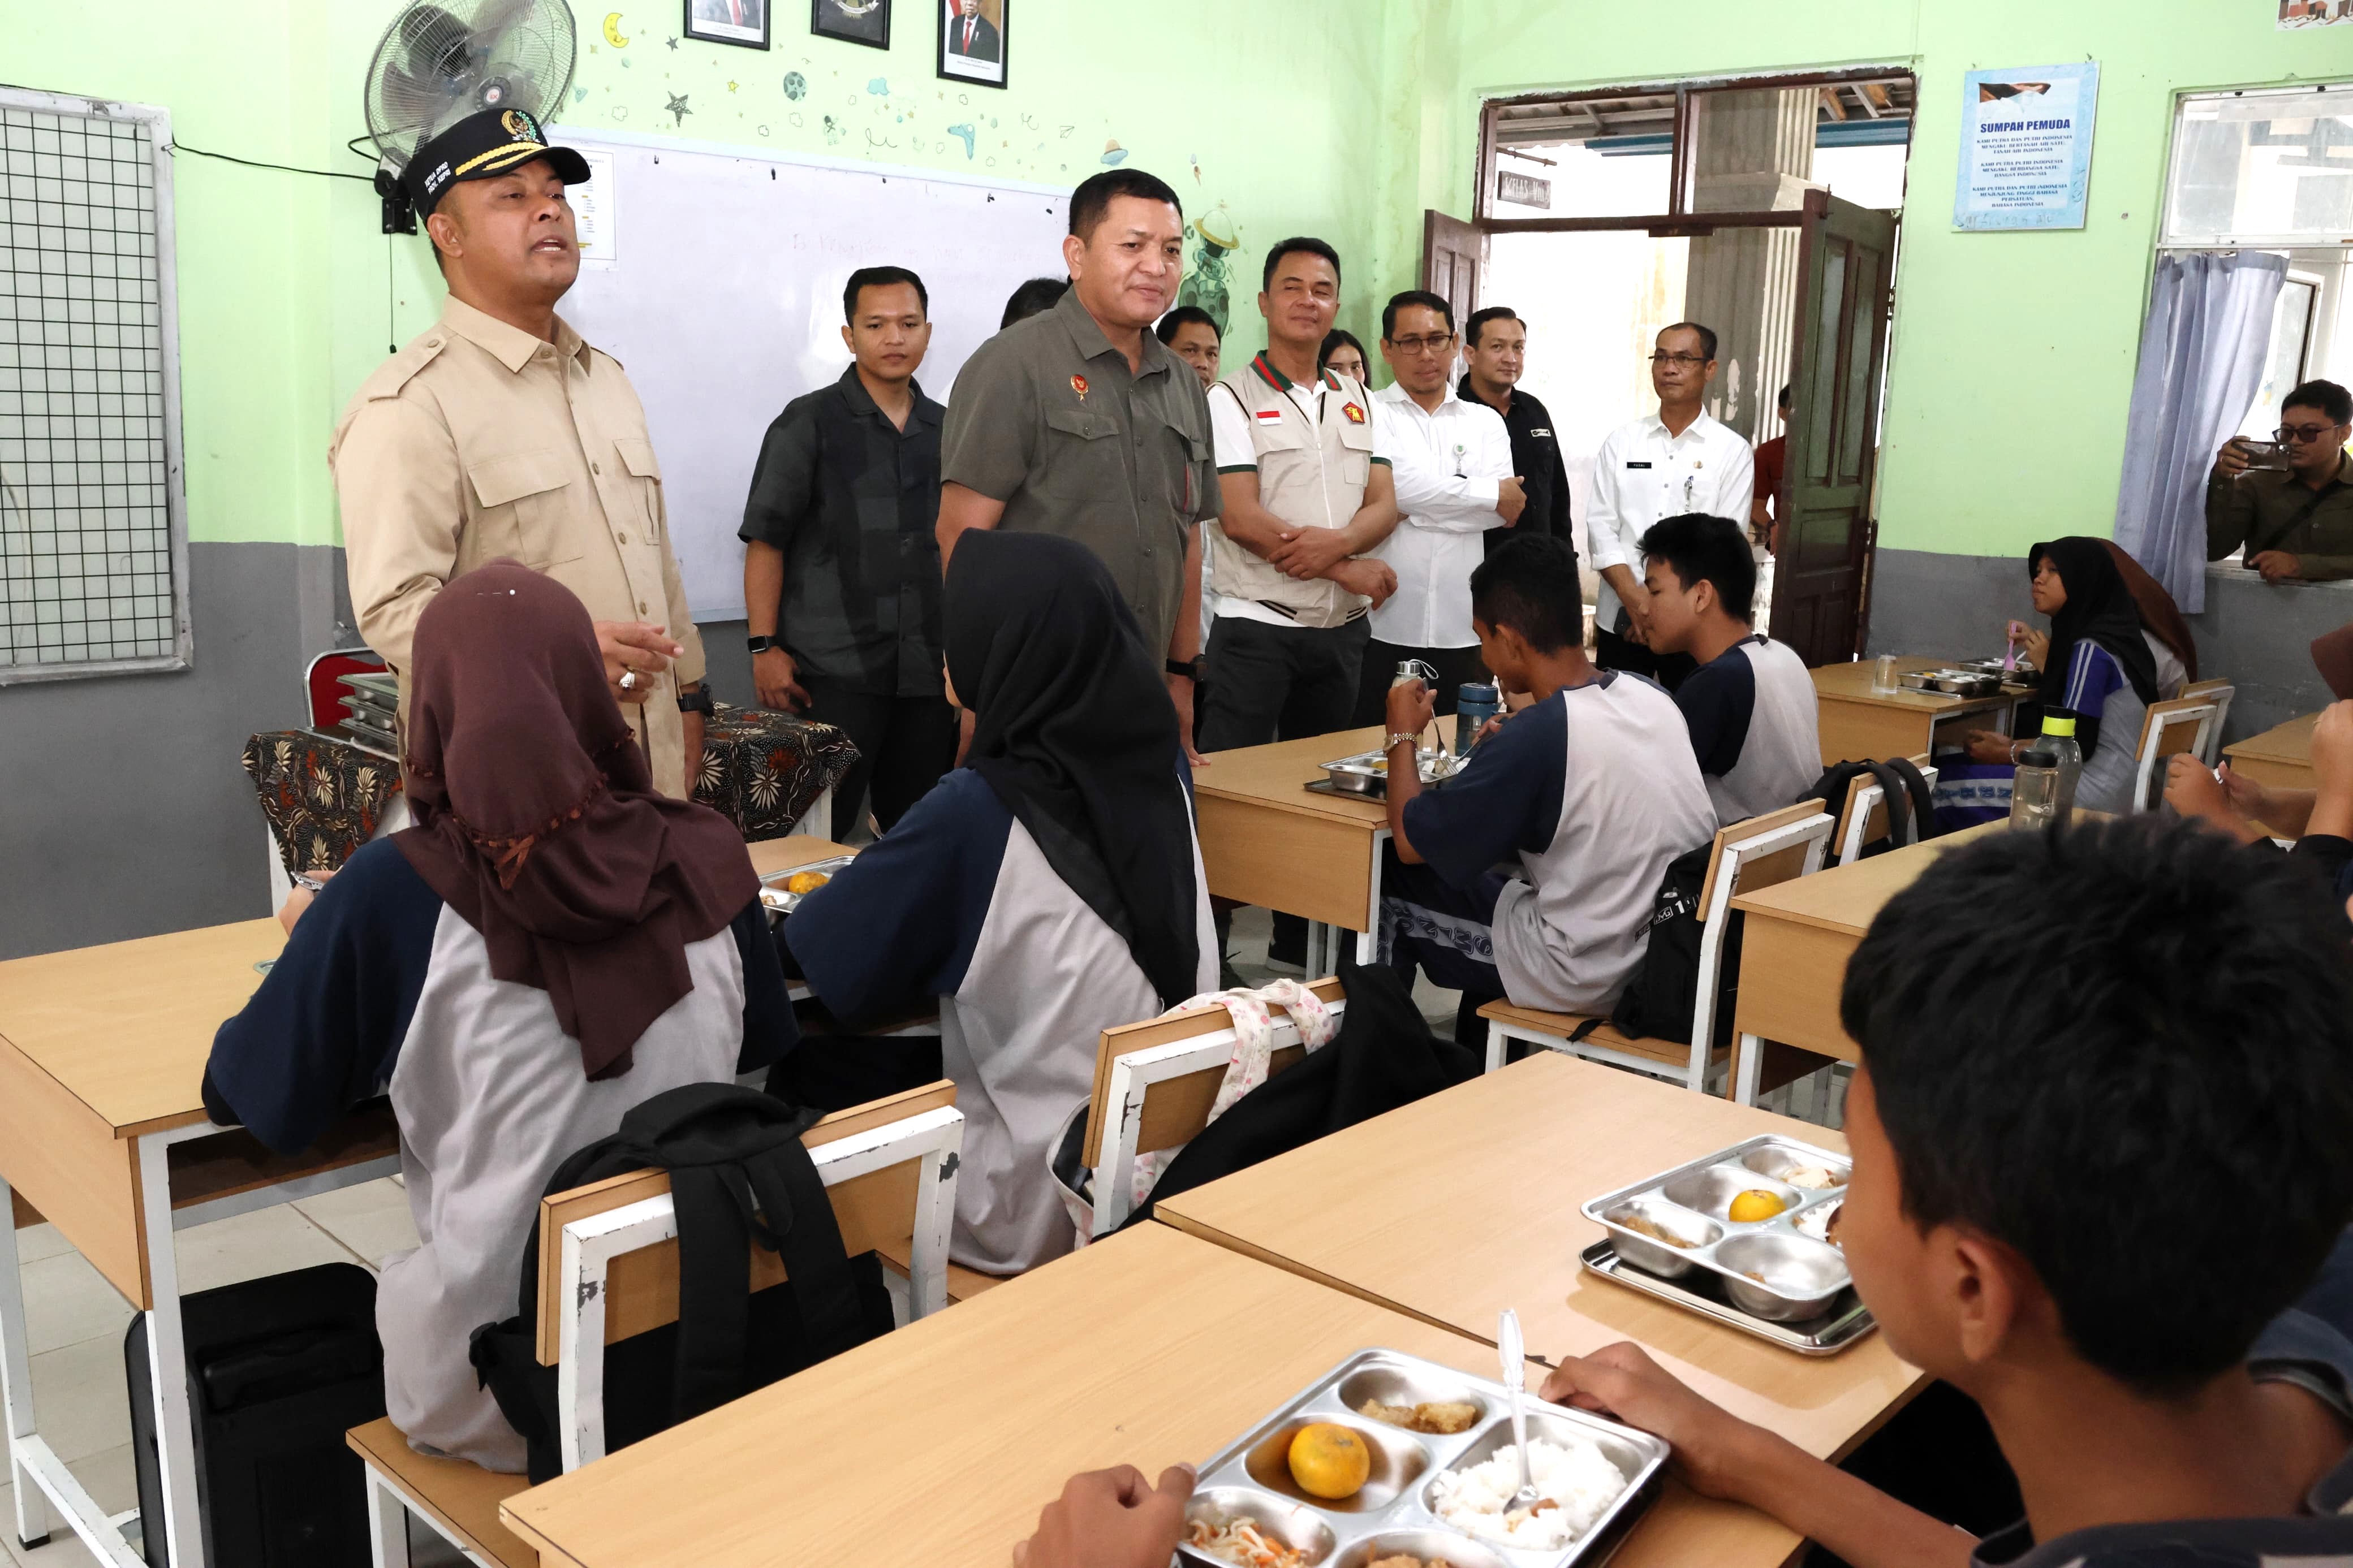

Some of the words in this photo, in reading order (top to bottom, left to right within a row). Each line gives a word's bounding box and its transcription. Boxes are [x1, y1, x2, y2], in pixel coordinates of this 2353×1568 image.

[1980, 121, 2024, 133] SUMPAH
[2027, 119, 2070, 130] PEMUDA
[424, 171, 436, 188] KETUA
[436, 161, 448, 175] DPRD
[437, 168, 451, 184] KEPRI
[1505, 176, 1528, 198] KELAS
